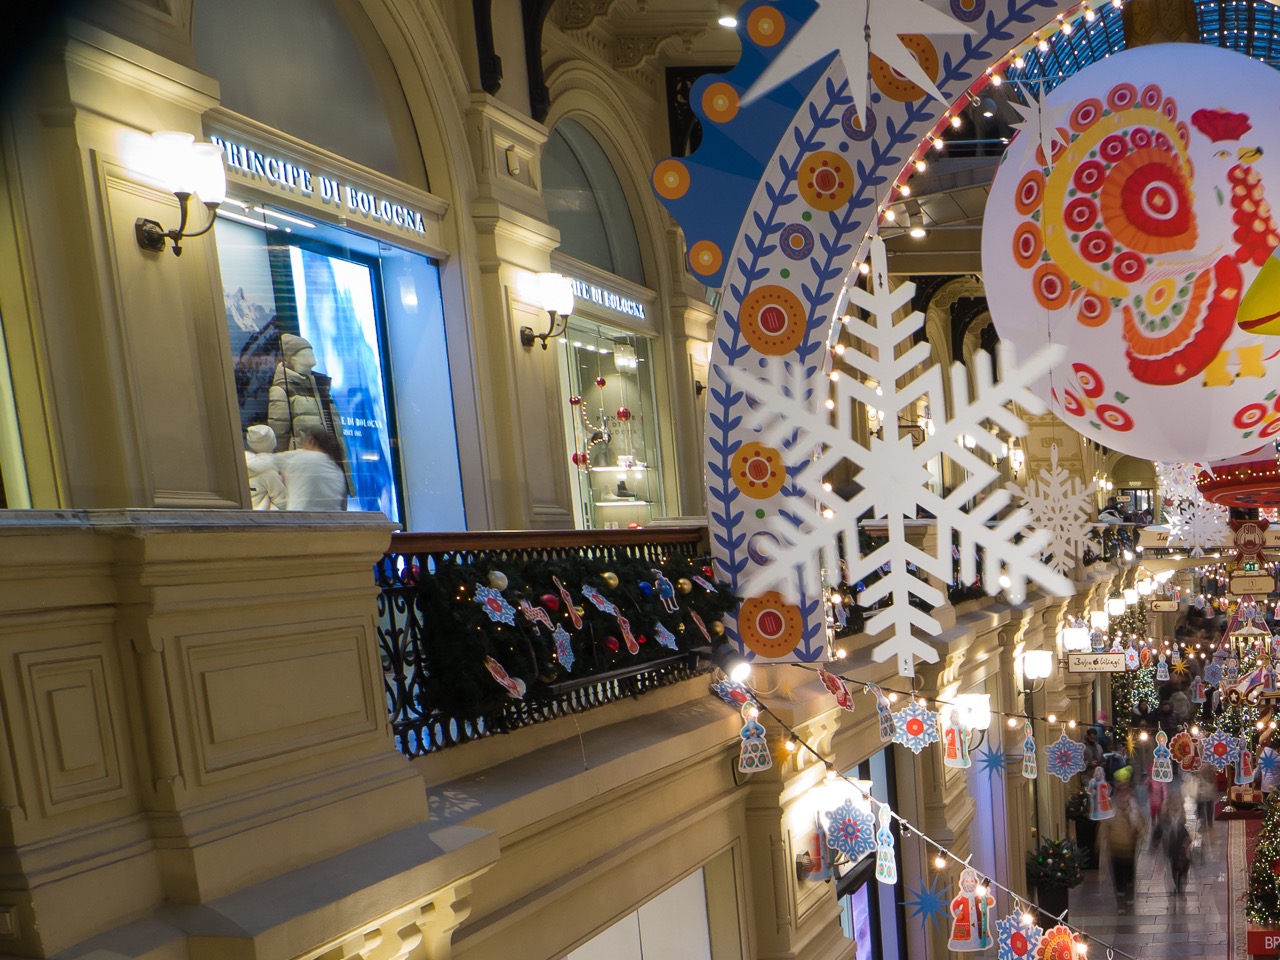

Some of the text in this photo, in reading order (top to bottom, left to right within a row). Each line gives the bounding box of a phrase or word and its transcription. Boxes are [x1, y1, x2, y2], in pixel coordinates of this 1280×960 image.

[211, 136, 426, 233] PRINCIPE DI BOLOGNA
